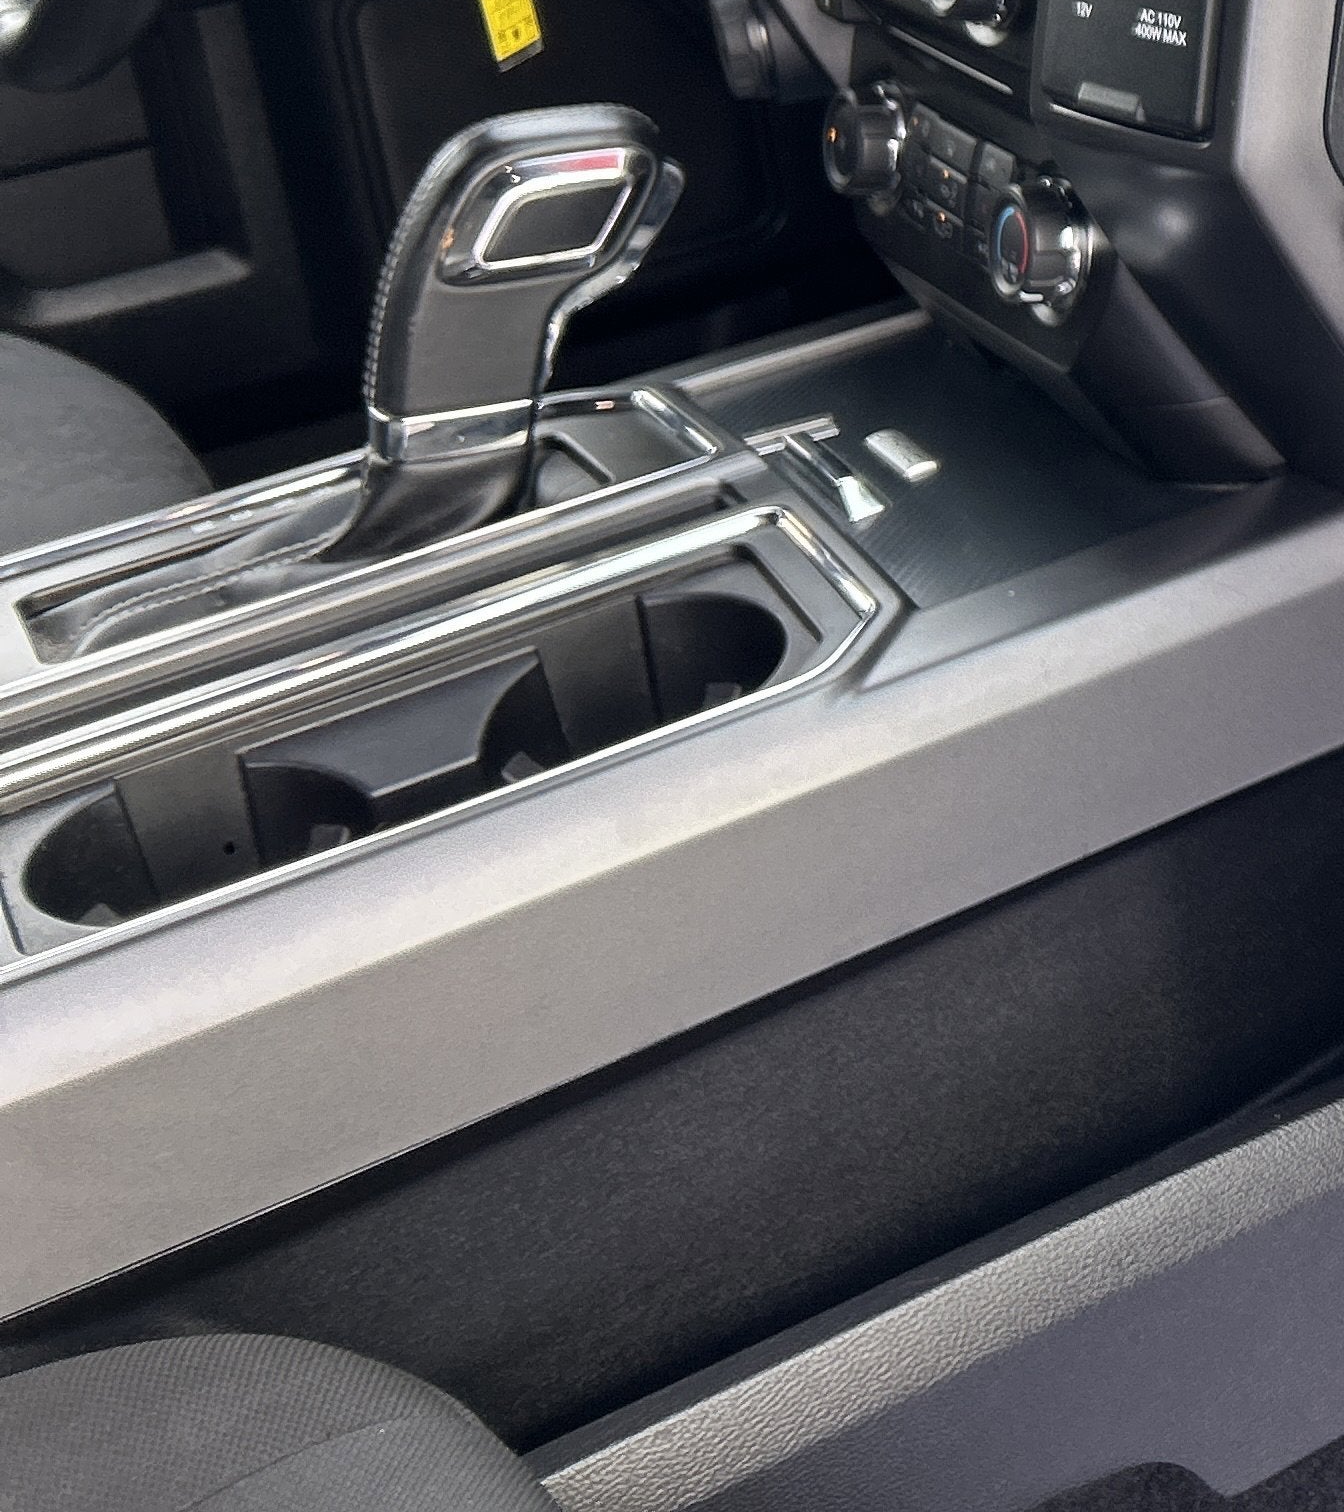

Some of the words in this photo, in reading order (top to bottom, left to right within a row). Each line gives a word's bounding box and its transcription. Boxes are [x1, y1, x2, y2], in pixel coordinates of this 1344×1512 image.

[1139, 8, 1156, 25] AC
[1157, 11, 1182, 30] 110V
[1162, 27, 1187, 47] MAX
